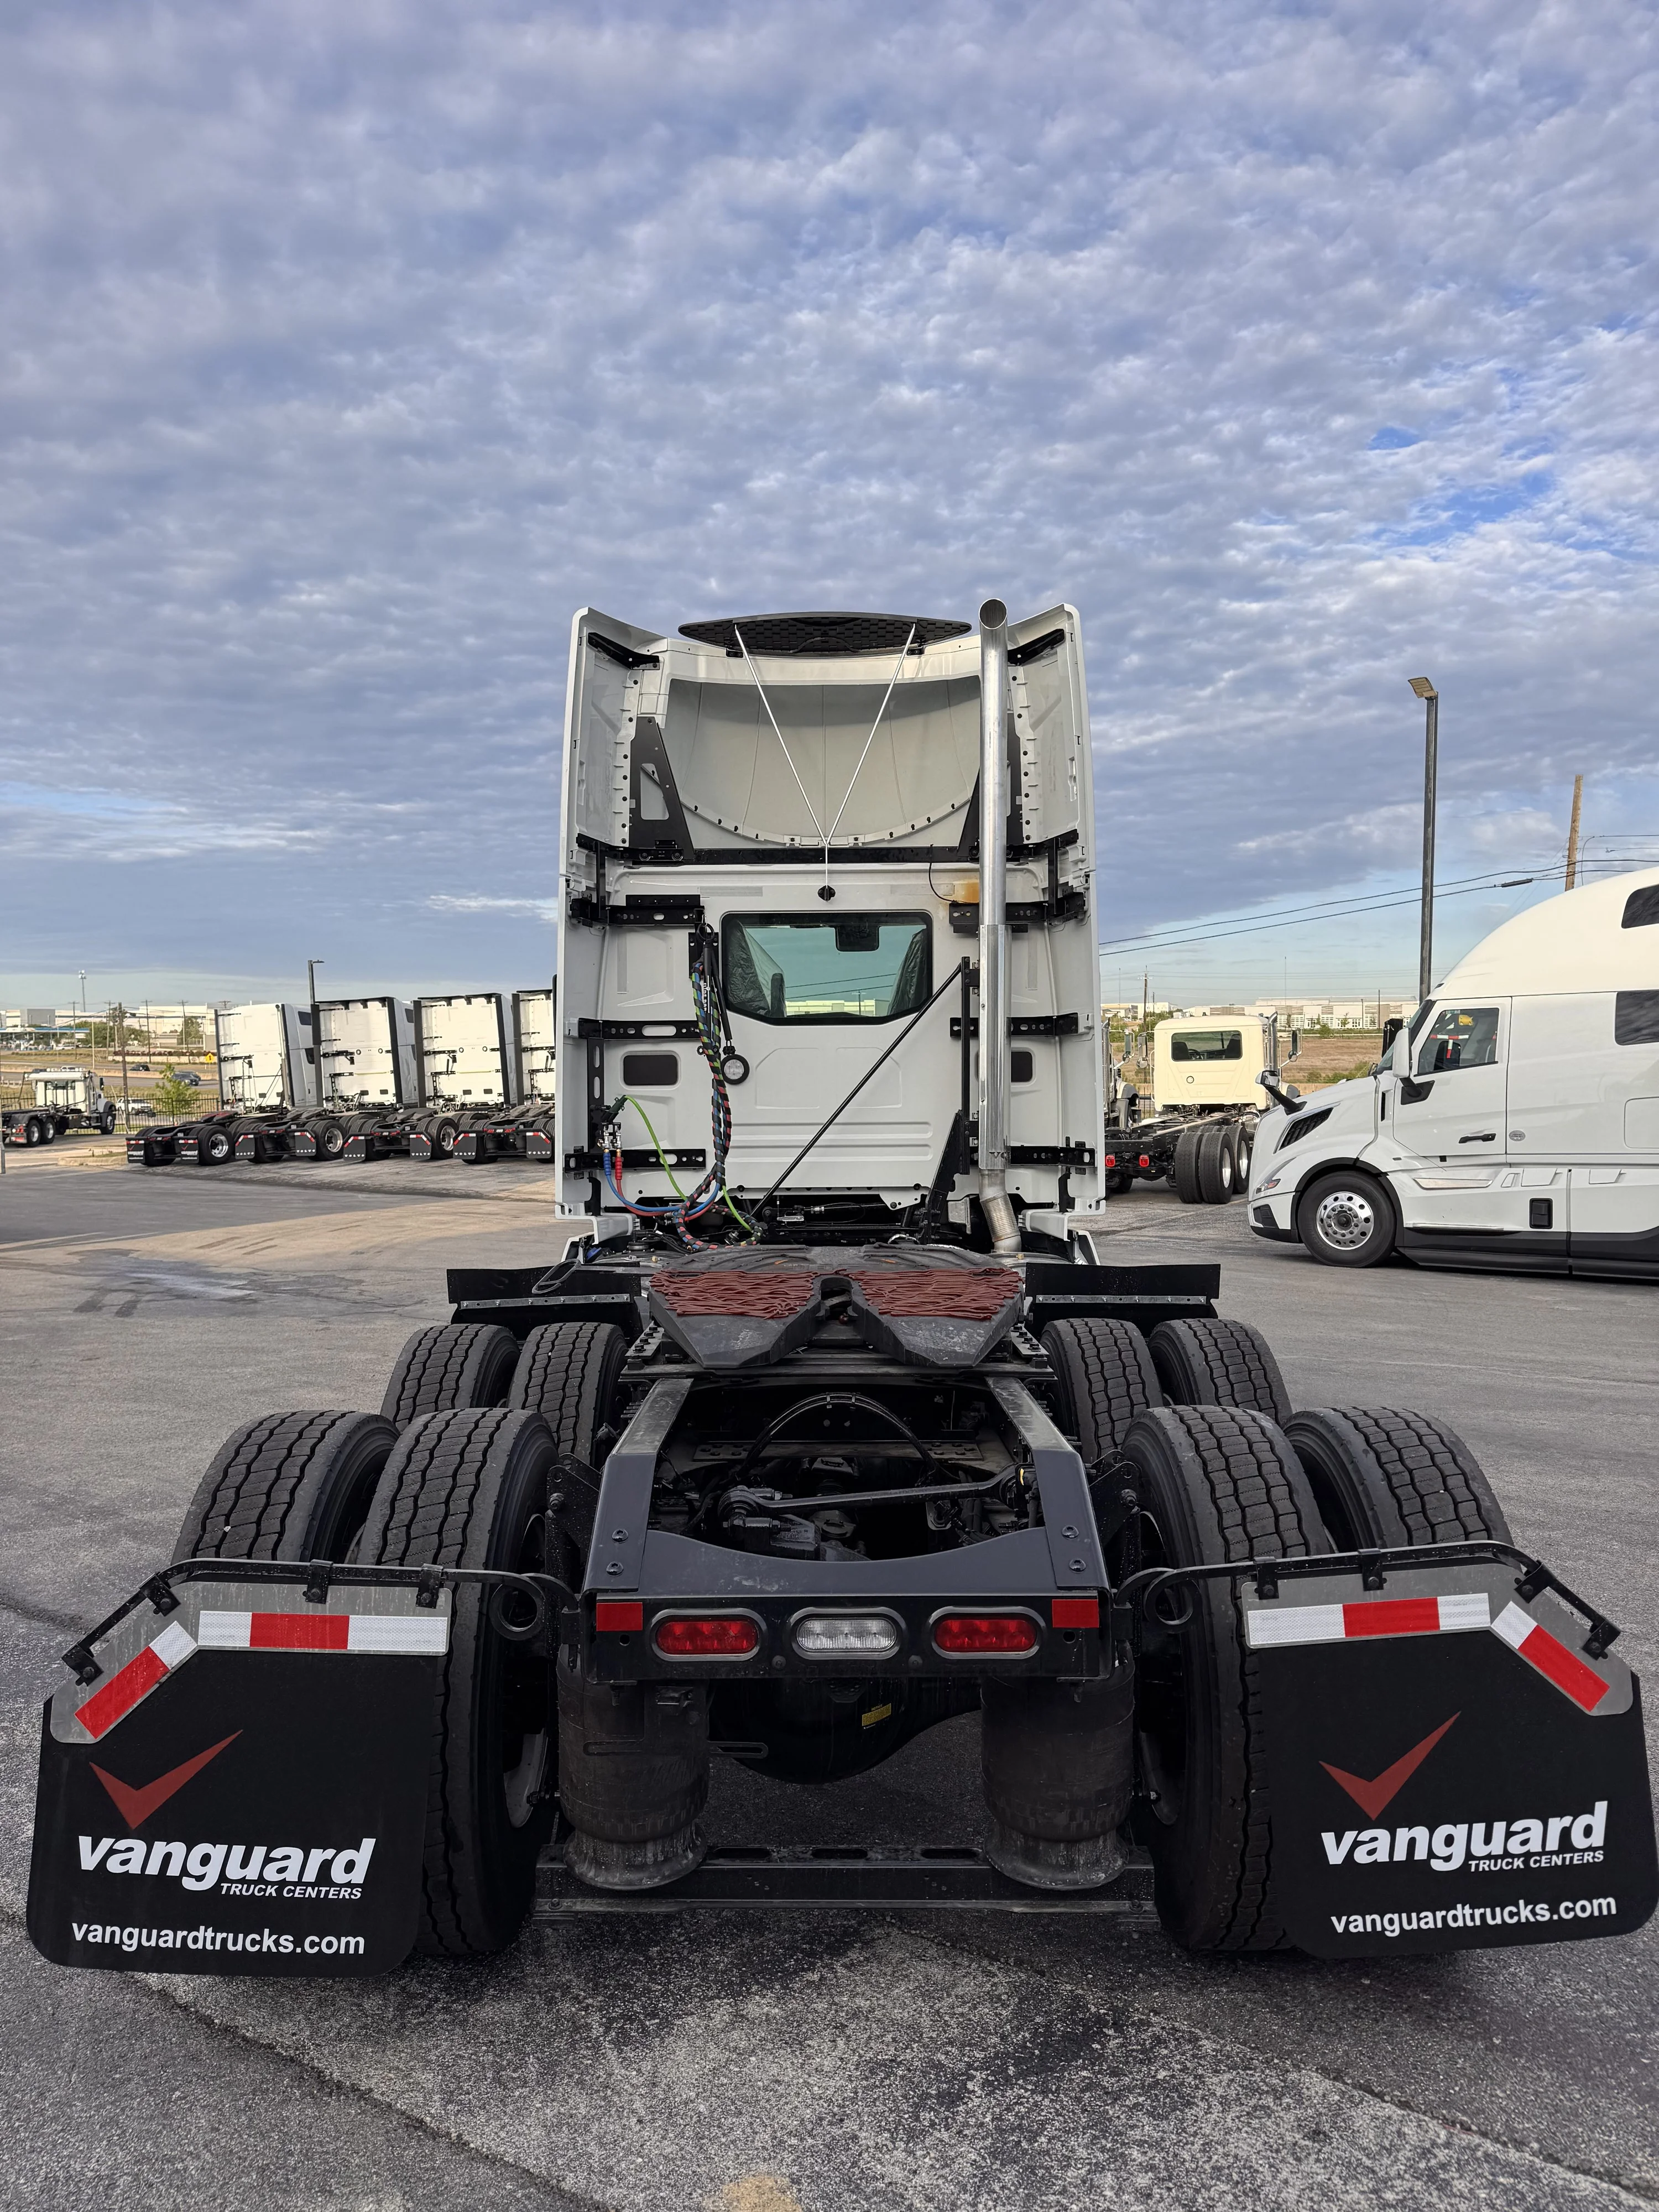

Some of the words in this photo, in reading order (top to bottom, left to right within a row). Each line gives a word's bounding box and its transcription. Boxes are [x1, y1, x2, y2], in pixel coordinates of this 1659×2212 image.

[1321, 1801, 1608, 1872] vanguard
[79, 1835, 377, 1891] vanguard
[1468, 1857, 1525, 1872] TRUCK
[1530, 1850, 1604, 1868] CENTERS
[220, 1883, 279, 1897] TRUCK
[283, 1886, 362, 1899] CENTERS
[1331, 1897, 1616, 1937] vanguardtrucks.com
[72, 1923, 365, 1954] vanguardtrucks.com
